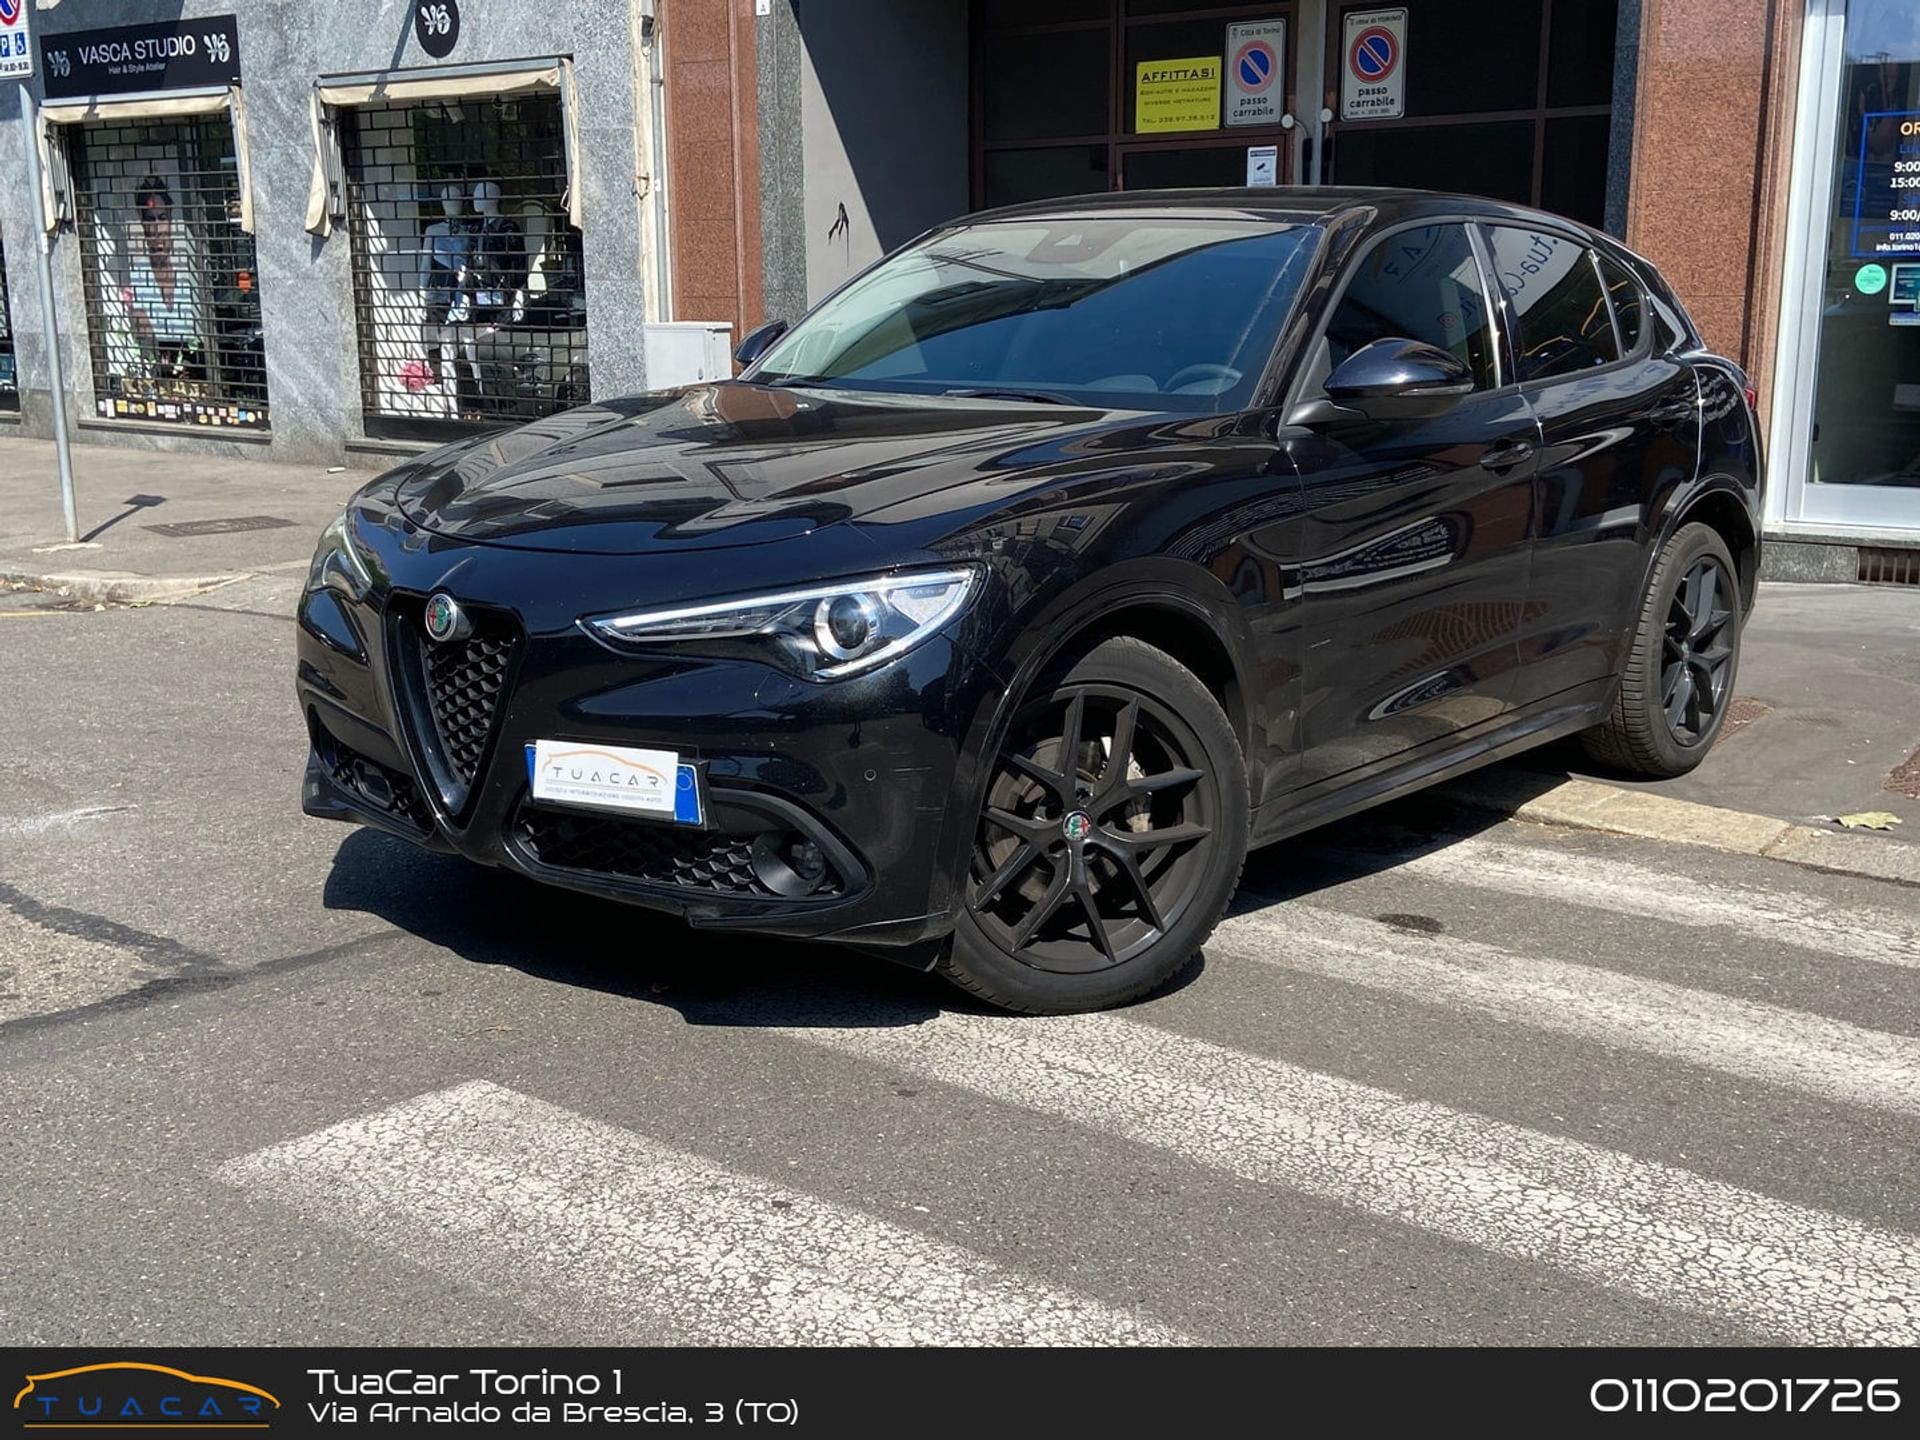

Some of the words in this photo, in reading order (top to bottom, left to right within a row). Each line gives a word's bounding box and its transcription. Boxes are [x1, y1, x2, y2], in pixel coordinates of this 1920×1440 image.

[78, 43, 131, 65] VASCA
[134, 34, 196, 60] STUDIO
[108, 65, 121, 75] Hair
[122, 64, 128, 74] &
[128, 64, 145, 75] Style
[146, 61, 166, 71] Atelier
[1142, 67, 1215, 83] AFFITTASI
[1358, 87, 1388, 98] passo
[1240, 96, 1268, 106] passo
[1349, 97, 1395, 108] carrabile
[1233, 106, 1274, 117] carrabile
[551, 766, 660, 788] TUACAR
